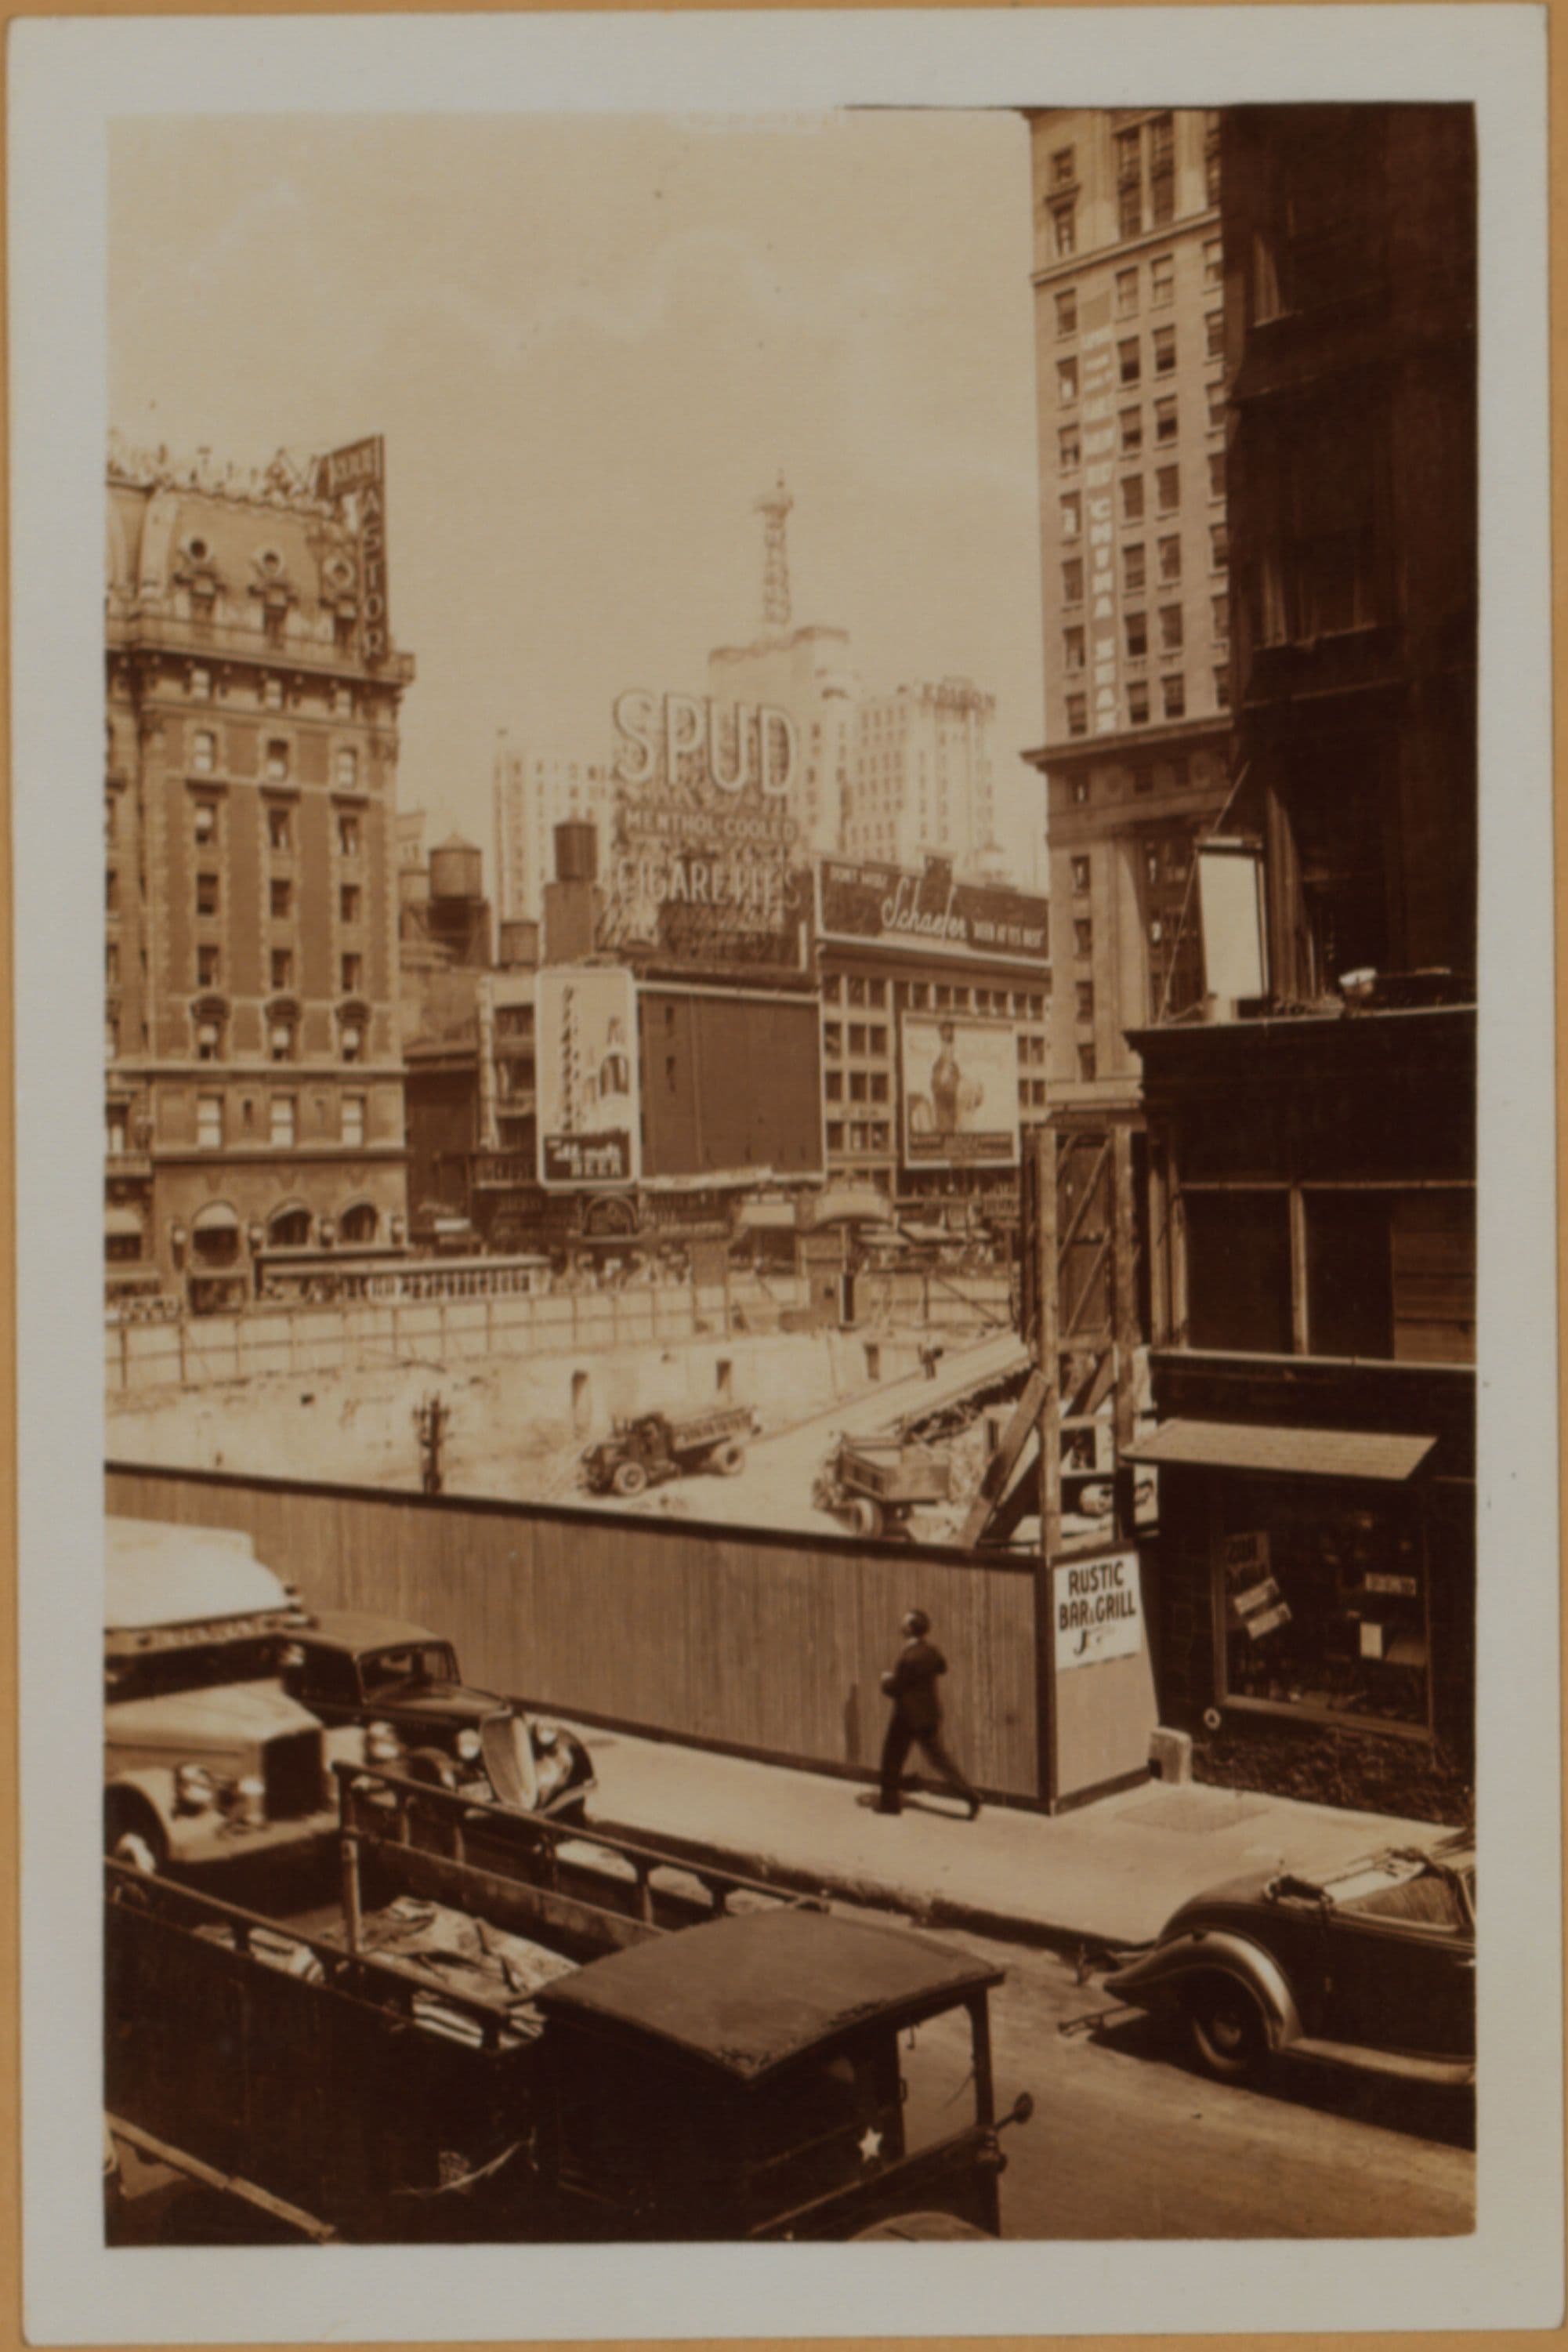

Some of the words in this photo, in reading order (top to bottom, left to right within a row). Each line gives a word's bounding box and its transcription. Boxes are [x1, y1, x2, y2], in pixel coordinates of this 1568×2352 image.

[361, 489, 385, 659] ASTOR
[613, 689, 800, 798] SPUD
[880, 875, 967, 945] Schaefer
[1059, 1600, 1089, 1630] BAR
[1095, 1591, 1136, 1622] GRILL
[1069, 1560, 1124, 1596] RUSTIC
